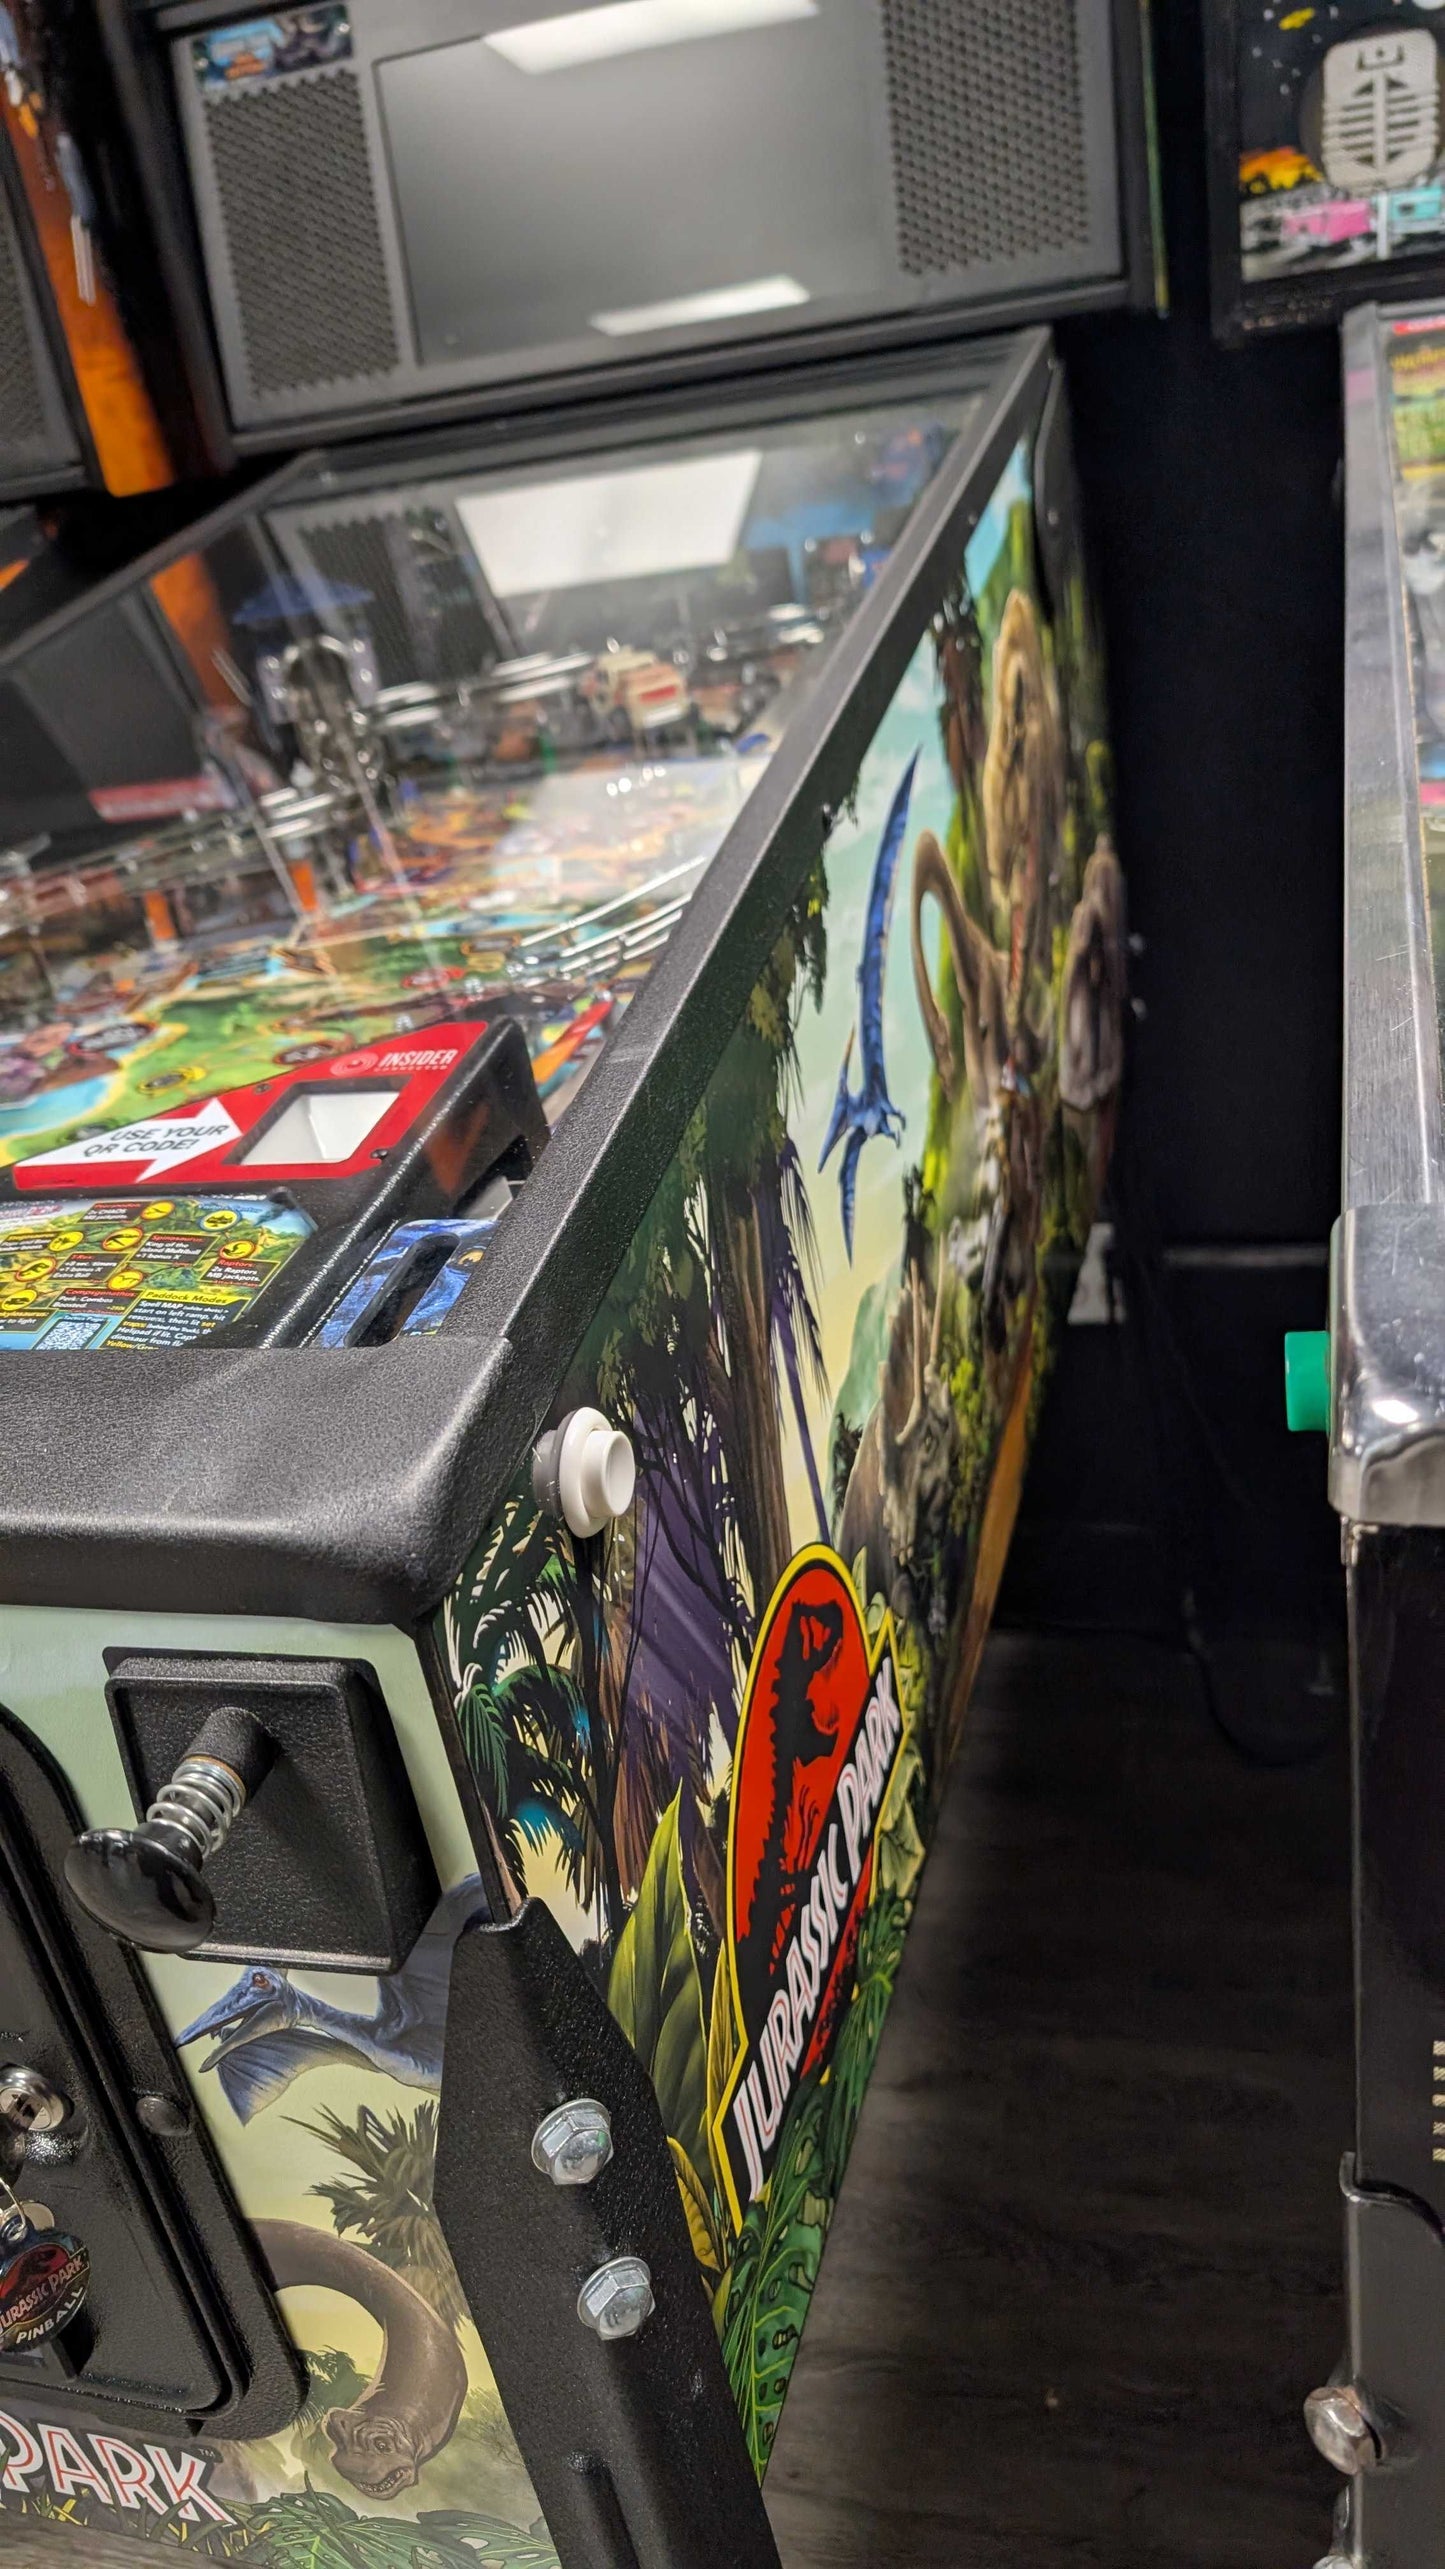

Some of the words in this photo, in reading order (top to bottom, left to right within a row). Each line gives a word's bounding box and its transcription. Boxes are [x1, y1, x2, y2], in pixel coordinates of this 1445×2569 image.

[378, 1048, 459, 1067] INSIDER
[110, 1128, 157, 1142] USE
[162, 1124, 230, 1139] YOUR
[83, 1144, 119, 1158] QR
[122, 1138, 200, 1153] CODE!
[223, 1267, 258, 1275] Raptors
[139, 1300, 161, 1309] Spell
[146, 1291, 188, 1300] Paddock
[192, 1294, 228, 1304] Modes
[168, 1309, 185, 1318] left
[212, 1313, 226, 1321] hit
[168, 1316, 190, 1324] then
[191, 1318, 201, 1326] lit
[110, 1333, 148, 1343] dinosaur
[149, 1337, 171, 1346] from
[732, 1823, 848, 2202] JURASSIC
[837, 1656, 900, 1886] PARK
[48, 2256, 83, 2294] PARK
[16, 2286, 84, 2344] PINBALL
[0, 2409, 238, 2525] PARK
